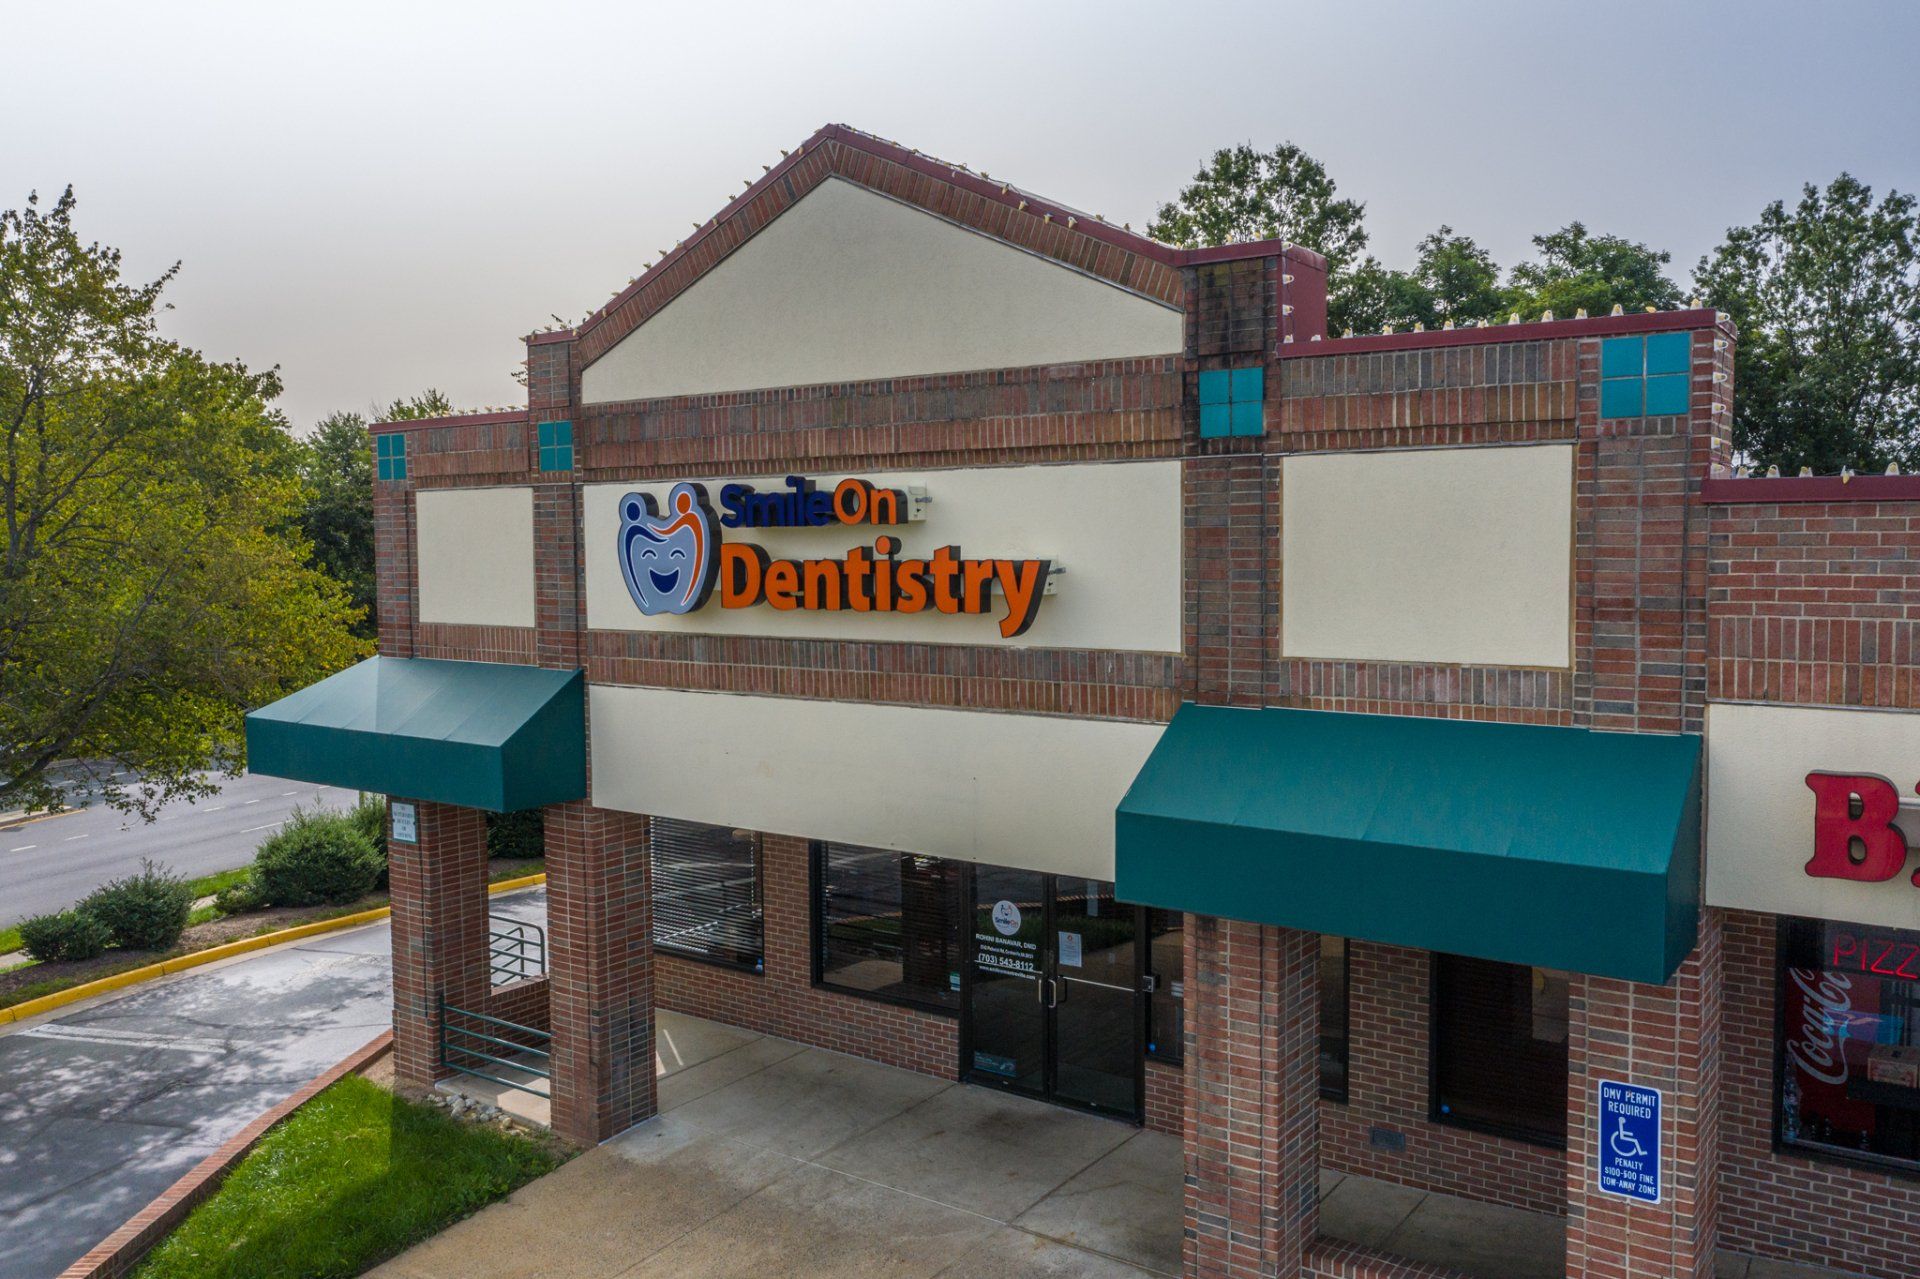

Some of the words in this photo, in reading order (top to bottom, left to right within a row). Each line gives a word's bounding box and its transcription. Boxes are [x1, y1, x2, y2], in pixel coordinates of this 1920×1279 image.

[720, 535, 1051, 638] Dentistry
[1805, 770, 1920, 888] B
[978, 953, 998, 964] (703)
[999, 957, 1034, 971] 543-8112
[1603, 1087, 1621, 1101] DMV
[1625, 1091, 1656, 1107] PERMIT
[1608, 1101, 1651, 1119] REQUIRED
[1615, 1157, 1643, 1171] PENALTY
[1603, 1176, 1635, 1191] TOW-AWAY
[1638, 1181, 1656, 1196] ZONE
[1640, 1174, 1654, 1185] FINE
